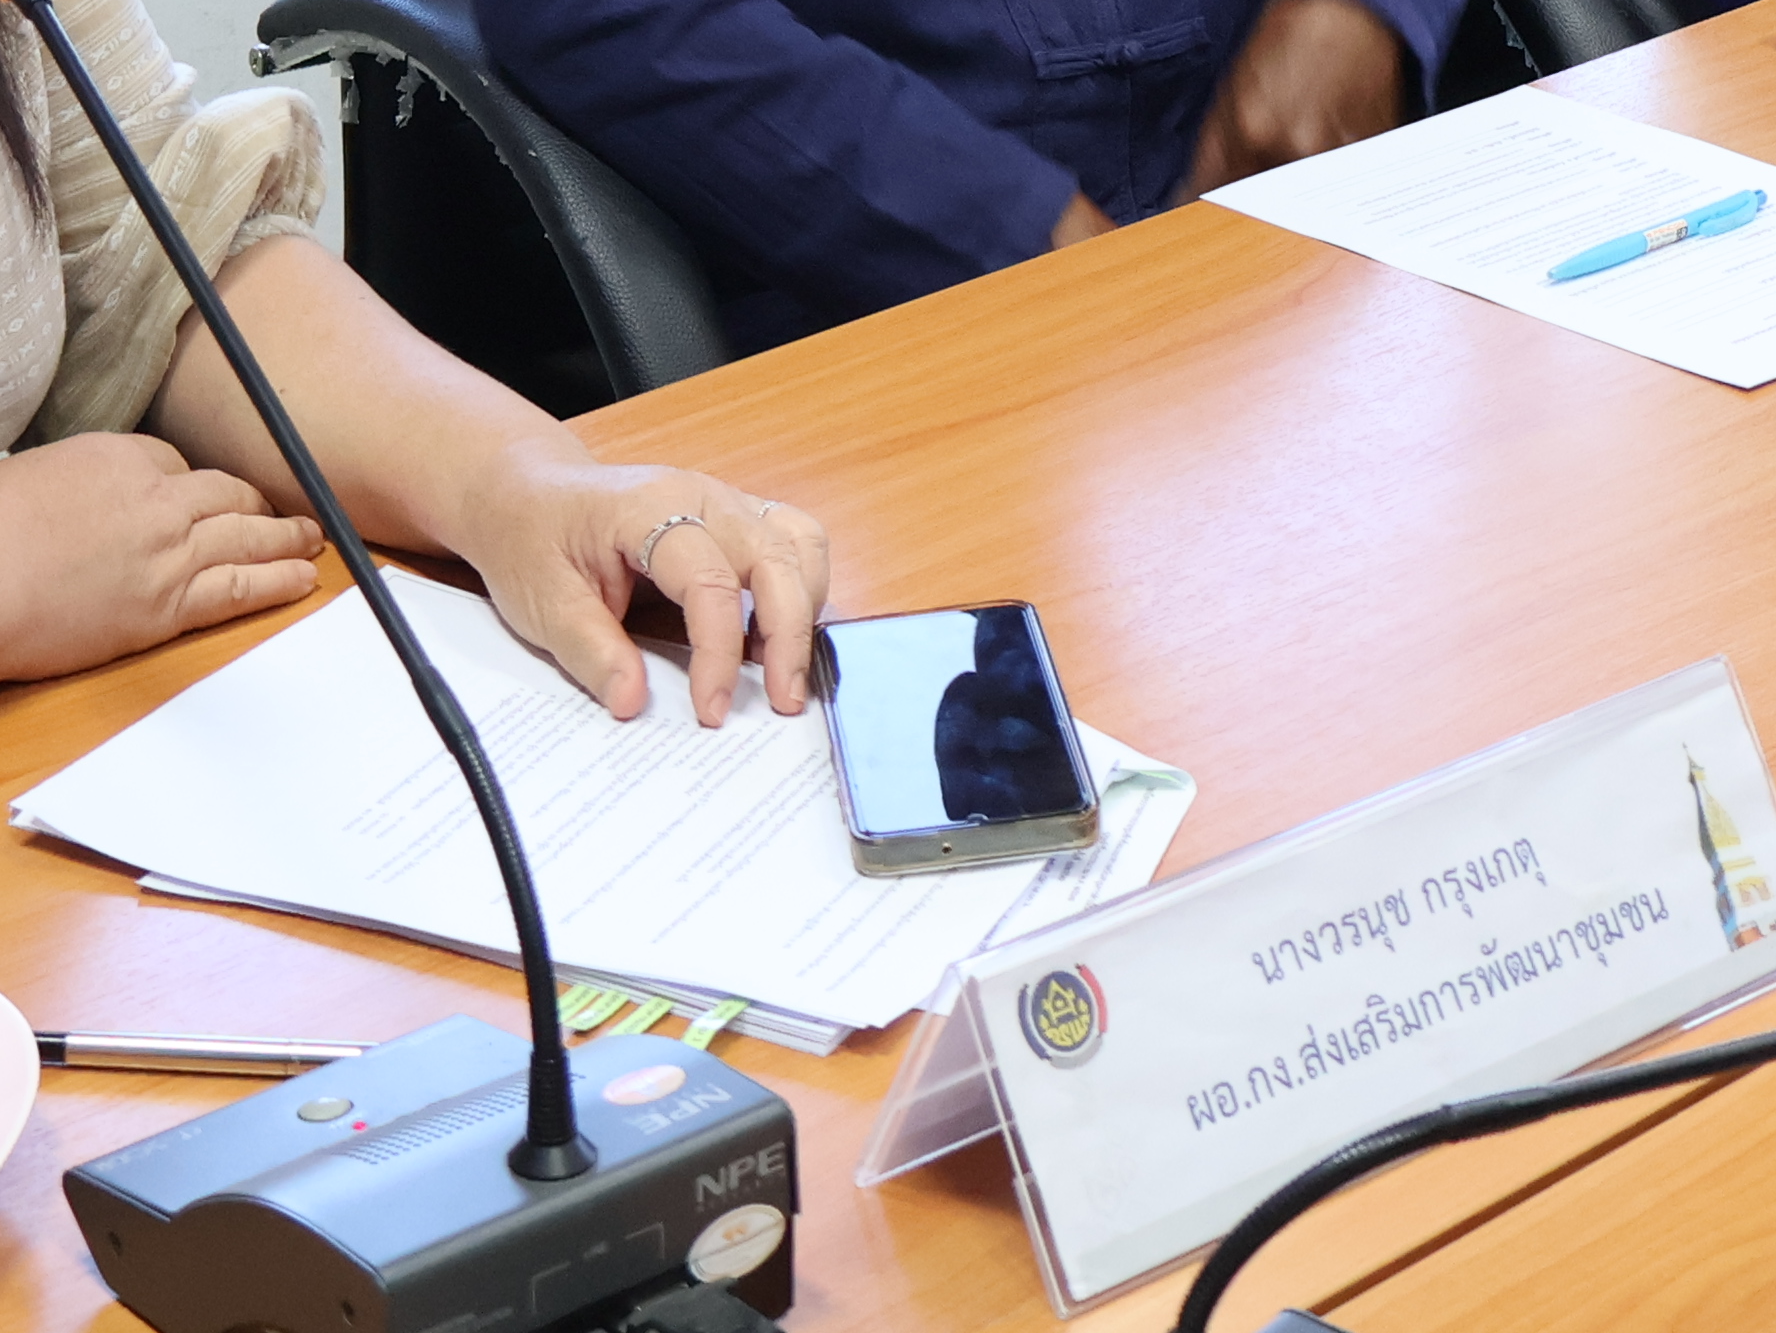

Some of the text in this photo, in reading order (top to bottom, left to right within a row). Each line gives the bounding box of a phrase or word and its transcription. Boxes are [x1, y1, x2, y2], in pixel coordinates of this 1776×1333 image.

[1253, 837, 1548, 984] นางวรนุช กรุงเกตุ
[696, 1141, 786, 1202] NPE
